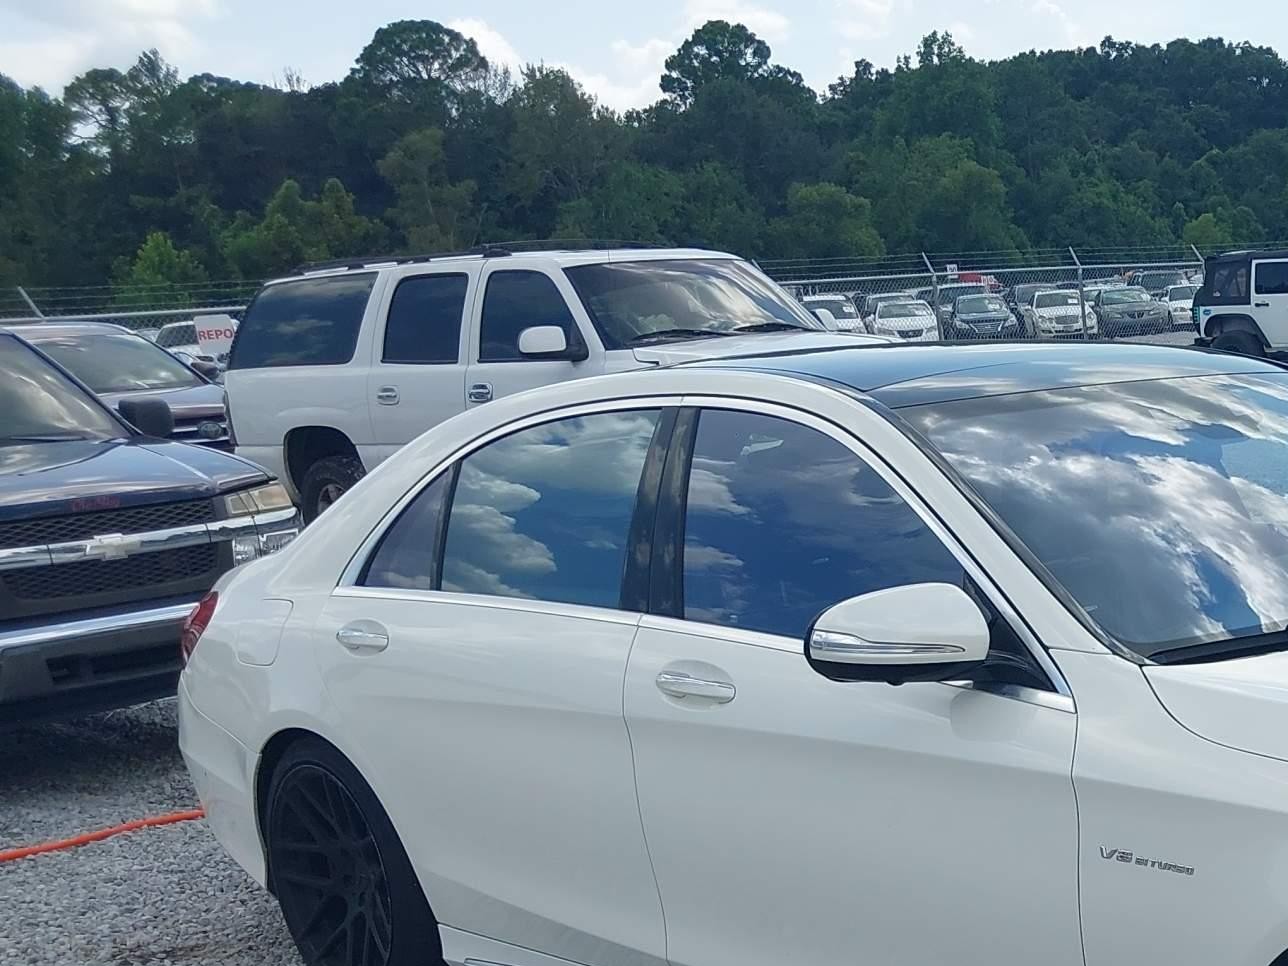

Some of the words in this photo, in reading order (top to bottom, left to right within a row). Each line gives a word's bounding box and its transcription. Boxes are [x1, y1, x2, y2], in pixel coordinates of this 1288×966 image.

[198, 328, 234, 341] REPO
[1099, 845, 1133, 863] V8
[1135, 856, 1195, 876] BITURBO
